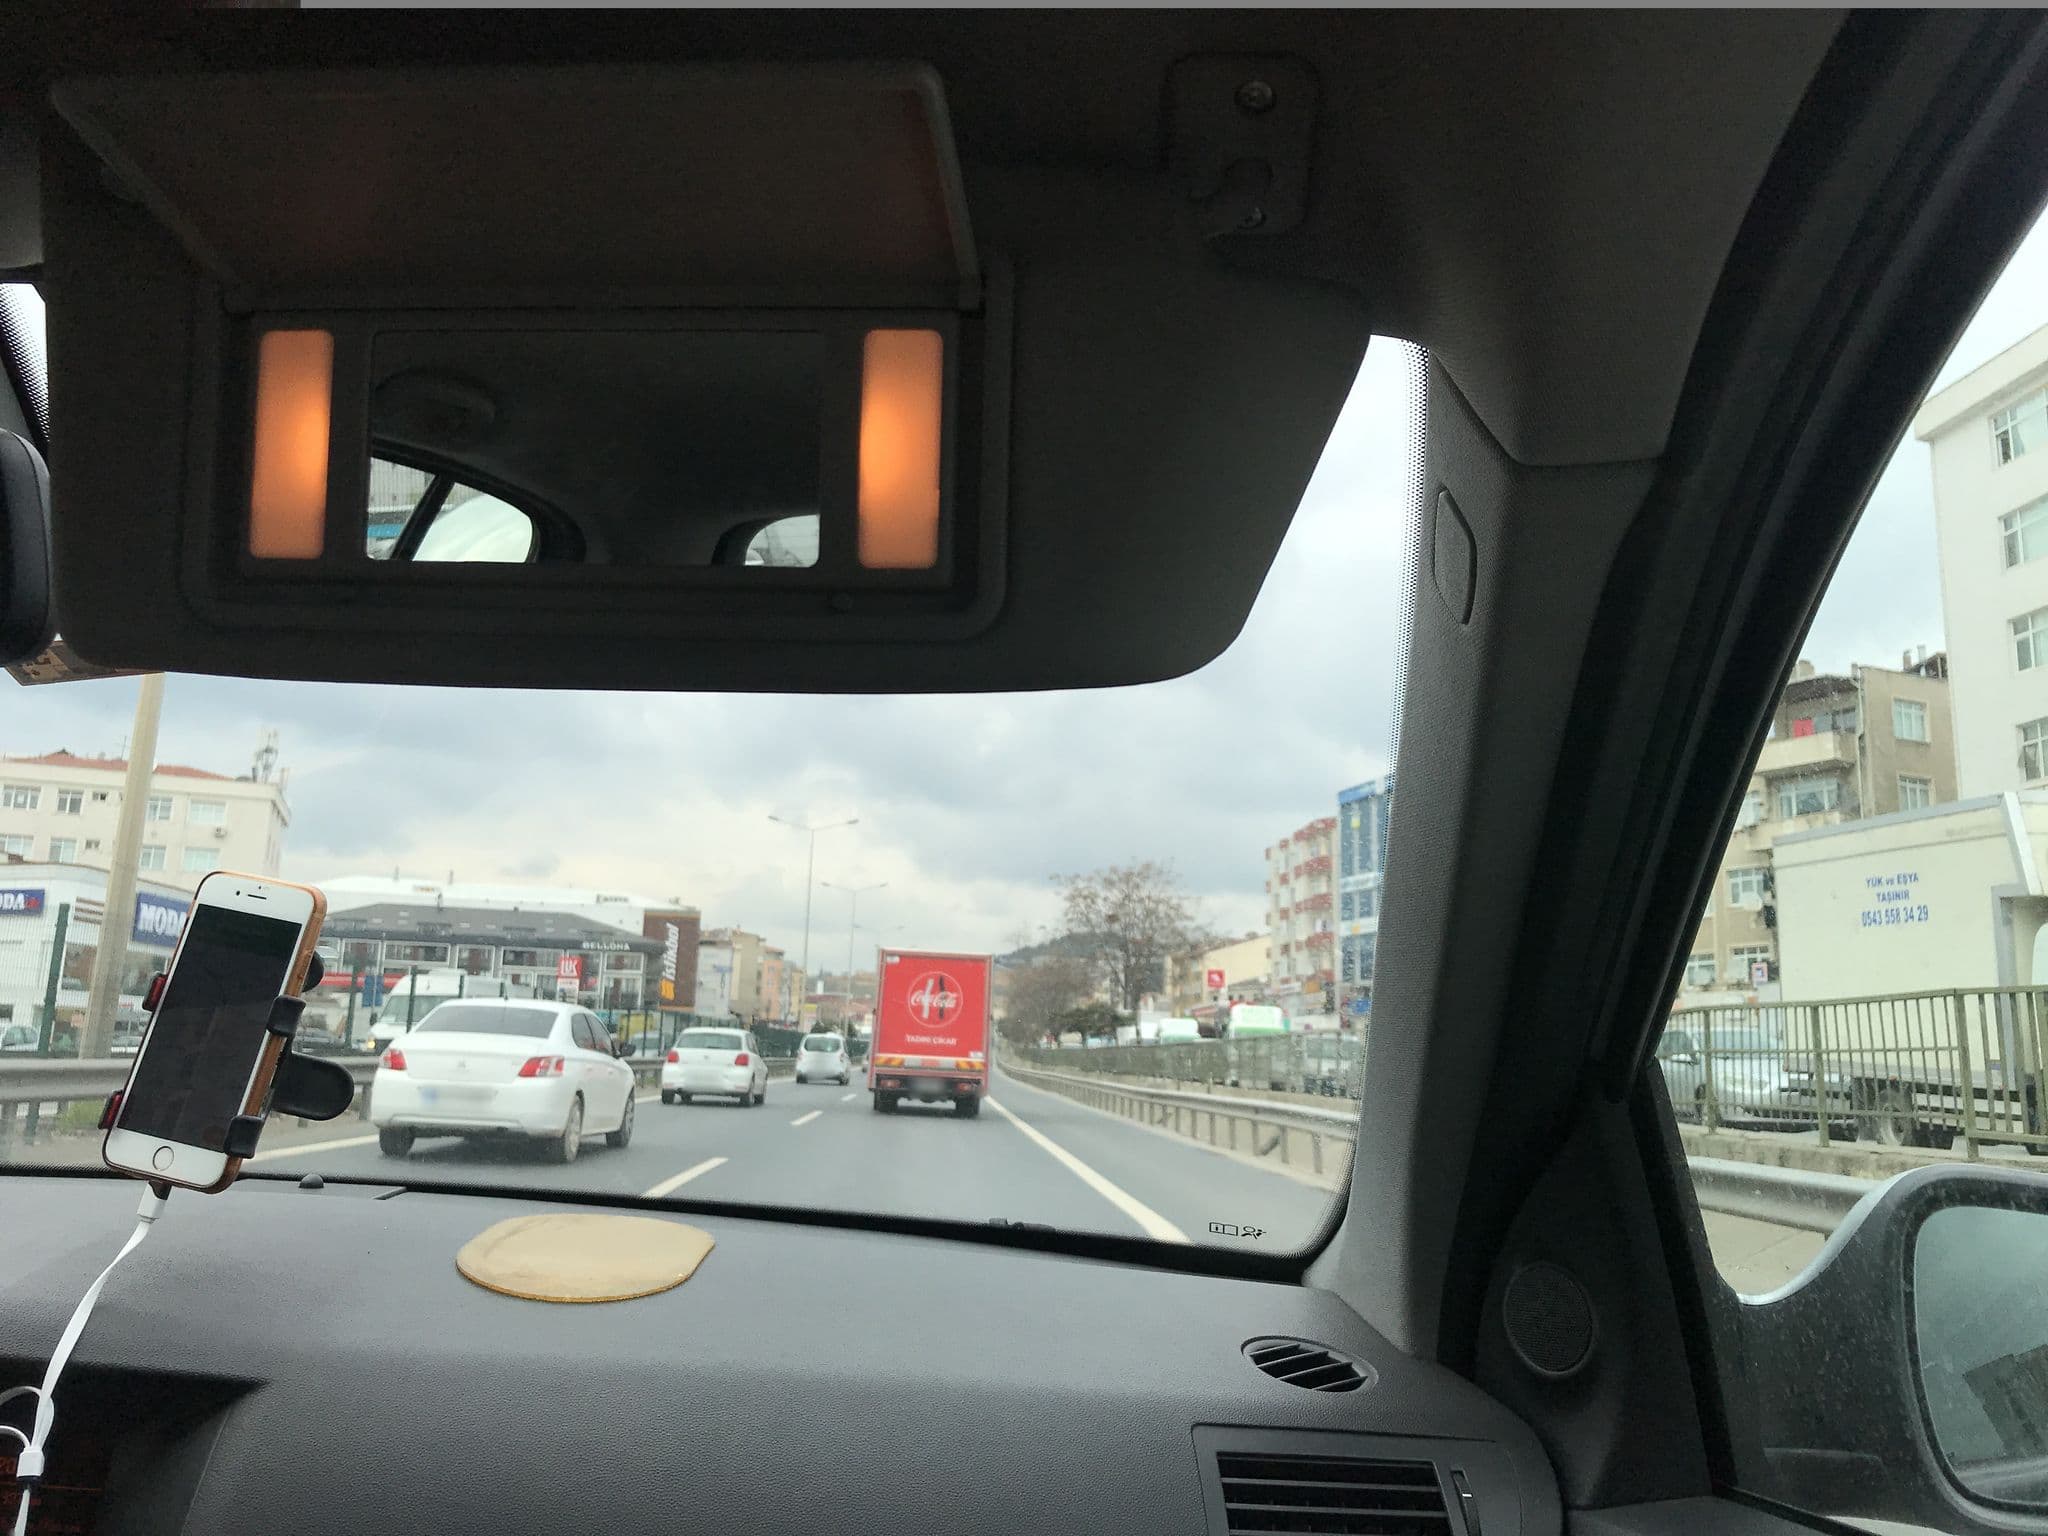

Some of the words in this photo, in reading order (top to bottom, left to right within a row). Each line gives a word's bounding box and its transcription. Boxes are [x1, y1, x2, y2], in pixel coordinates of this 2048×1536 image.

[1862, 909, 1883, 927] 0543
[1903, 906, 1915, 923] 34
[582, 941, 631, 951] BELLONA
